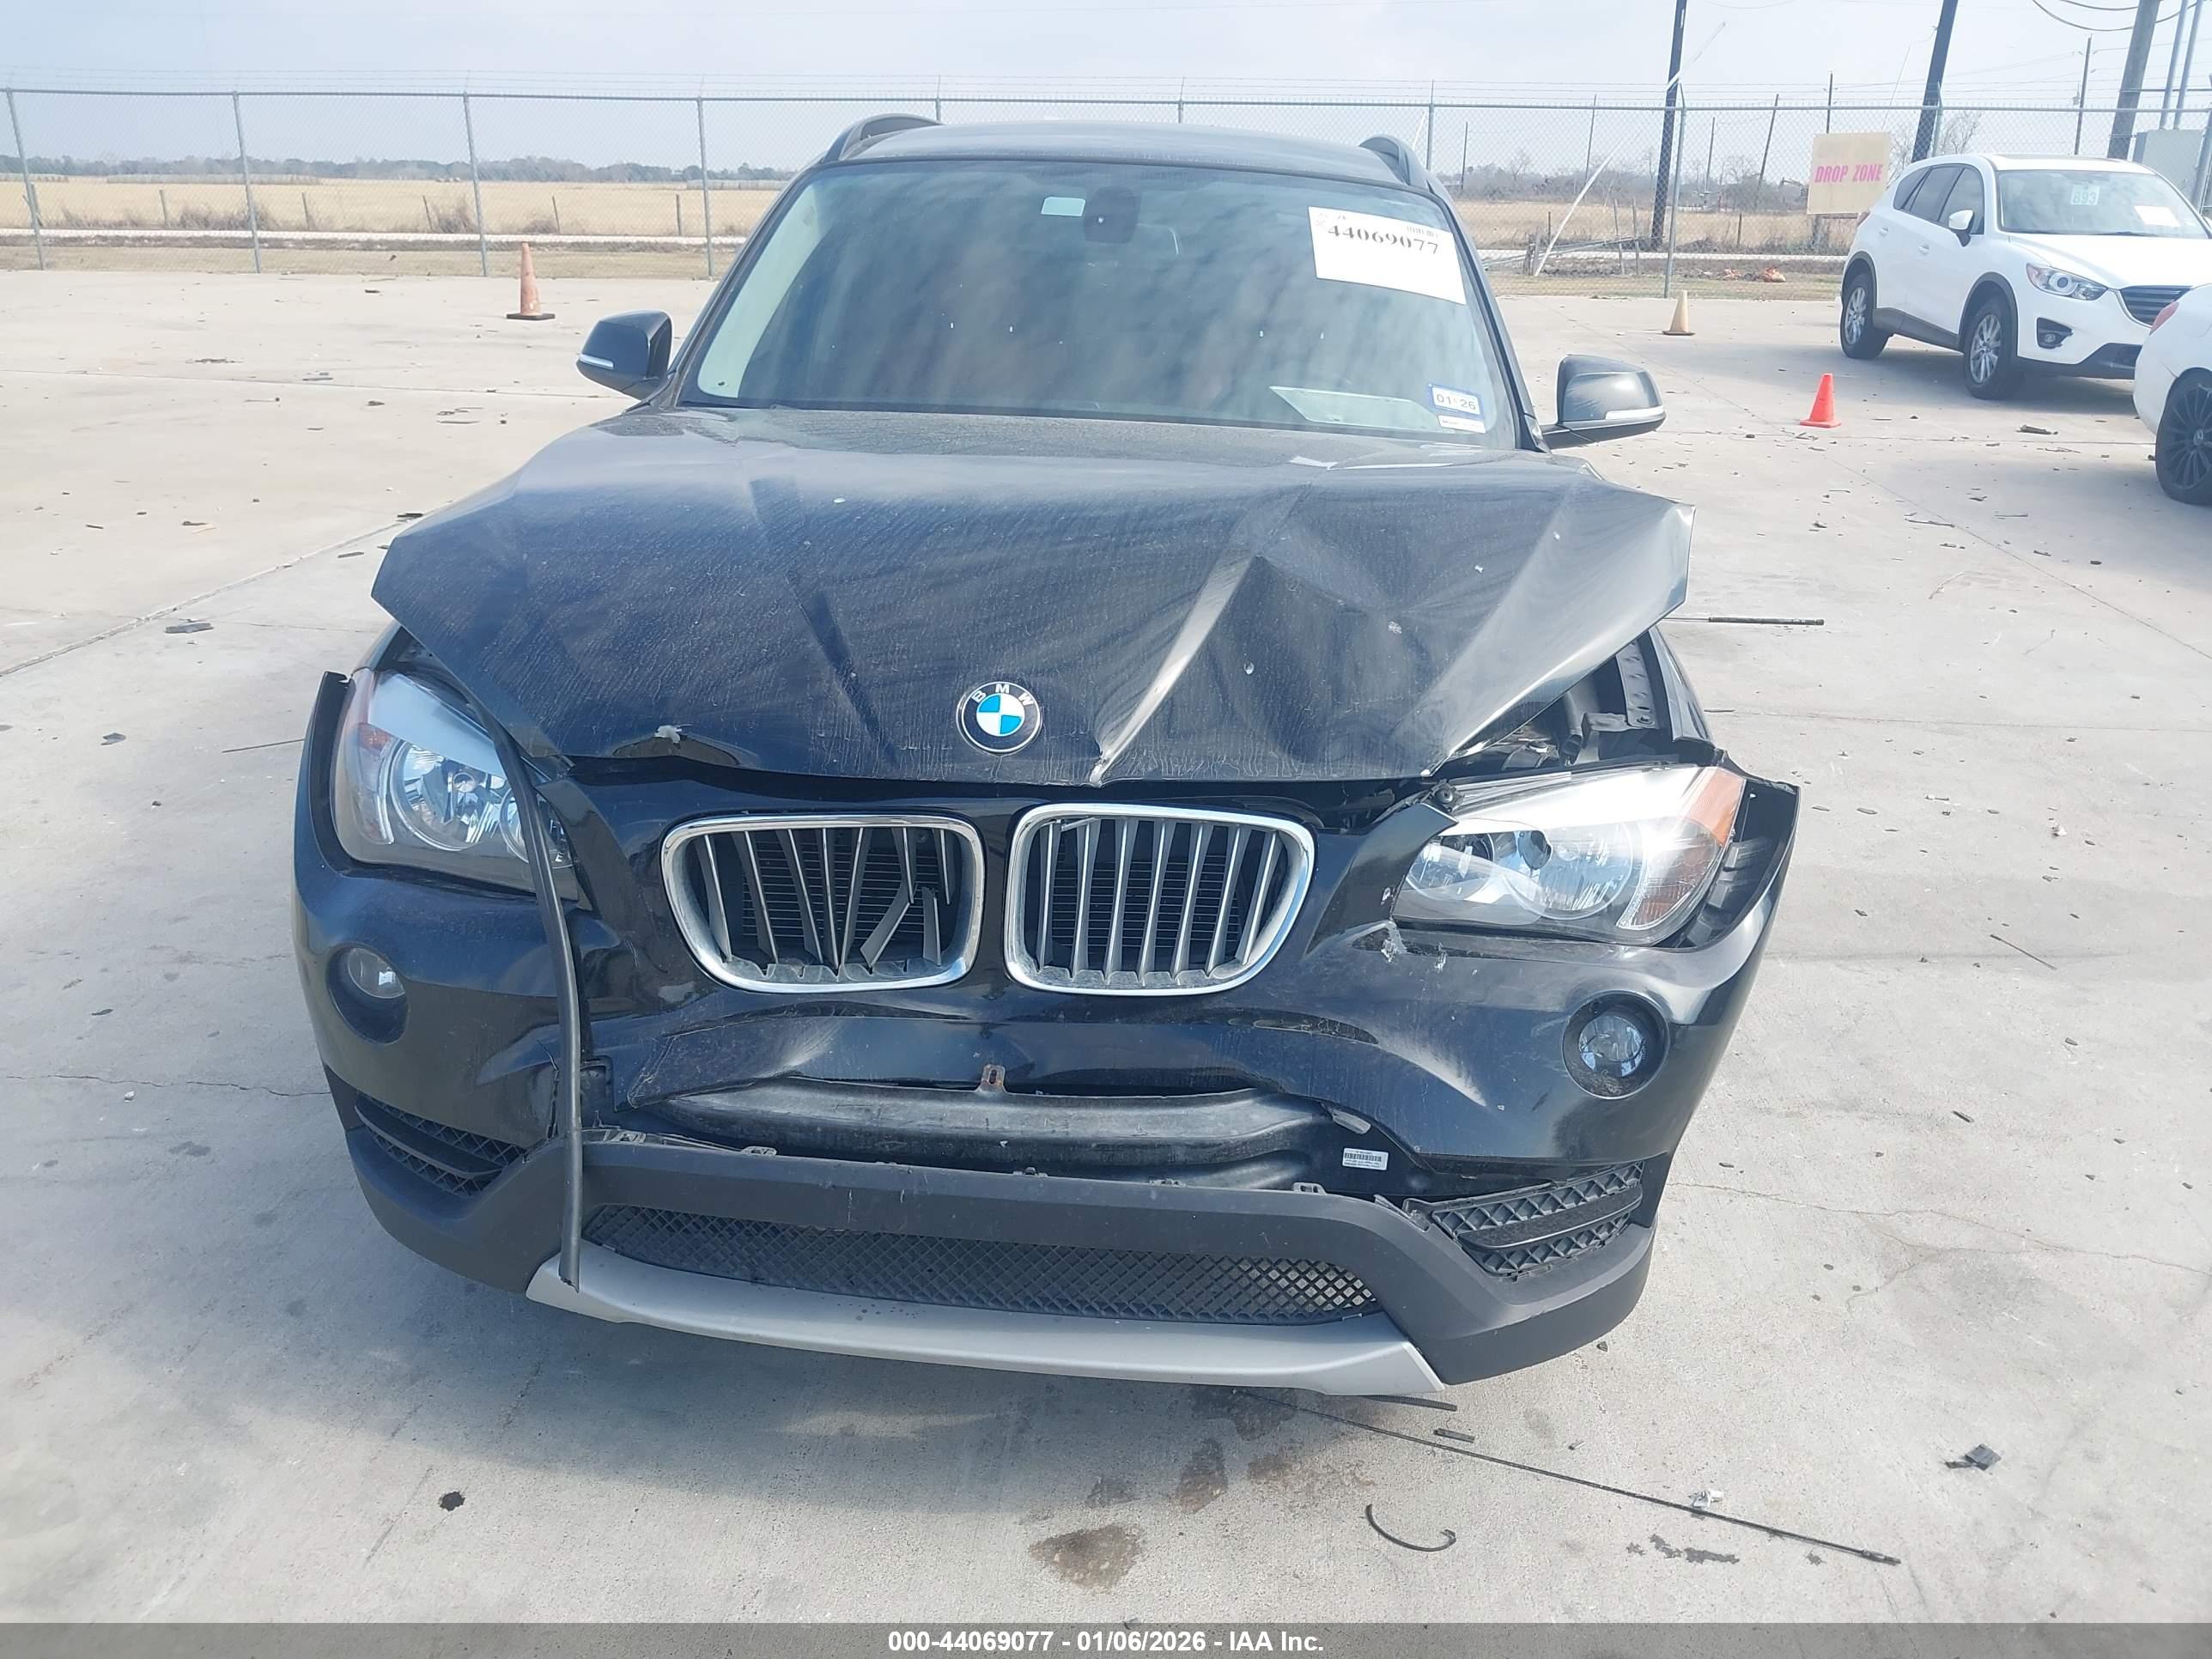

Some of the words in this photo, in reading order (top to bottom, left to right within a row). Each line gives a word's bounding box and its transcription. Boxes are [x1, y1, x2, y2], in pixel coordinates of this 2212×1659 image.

[1814, 165, 1848, 183] DROP
[1852, 164, 1883, 182] ZONE
[1328, 225, 1438, 254] 44069077
[971, 684, 1035, 706] BMW
